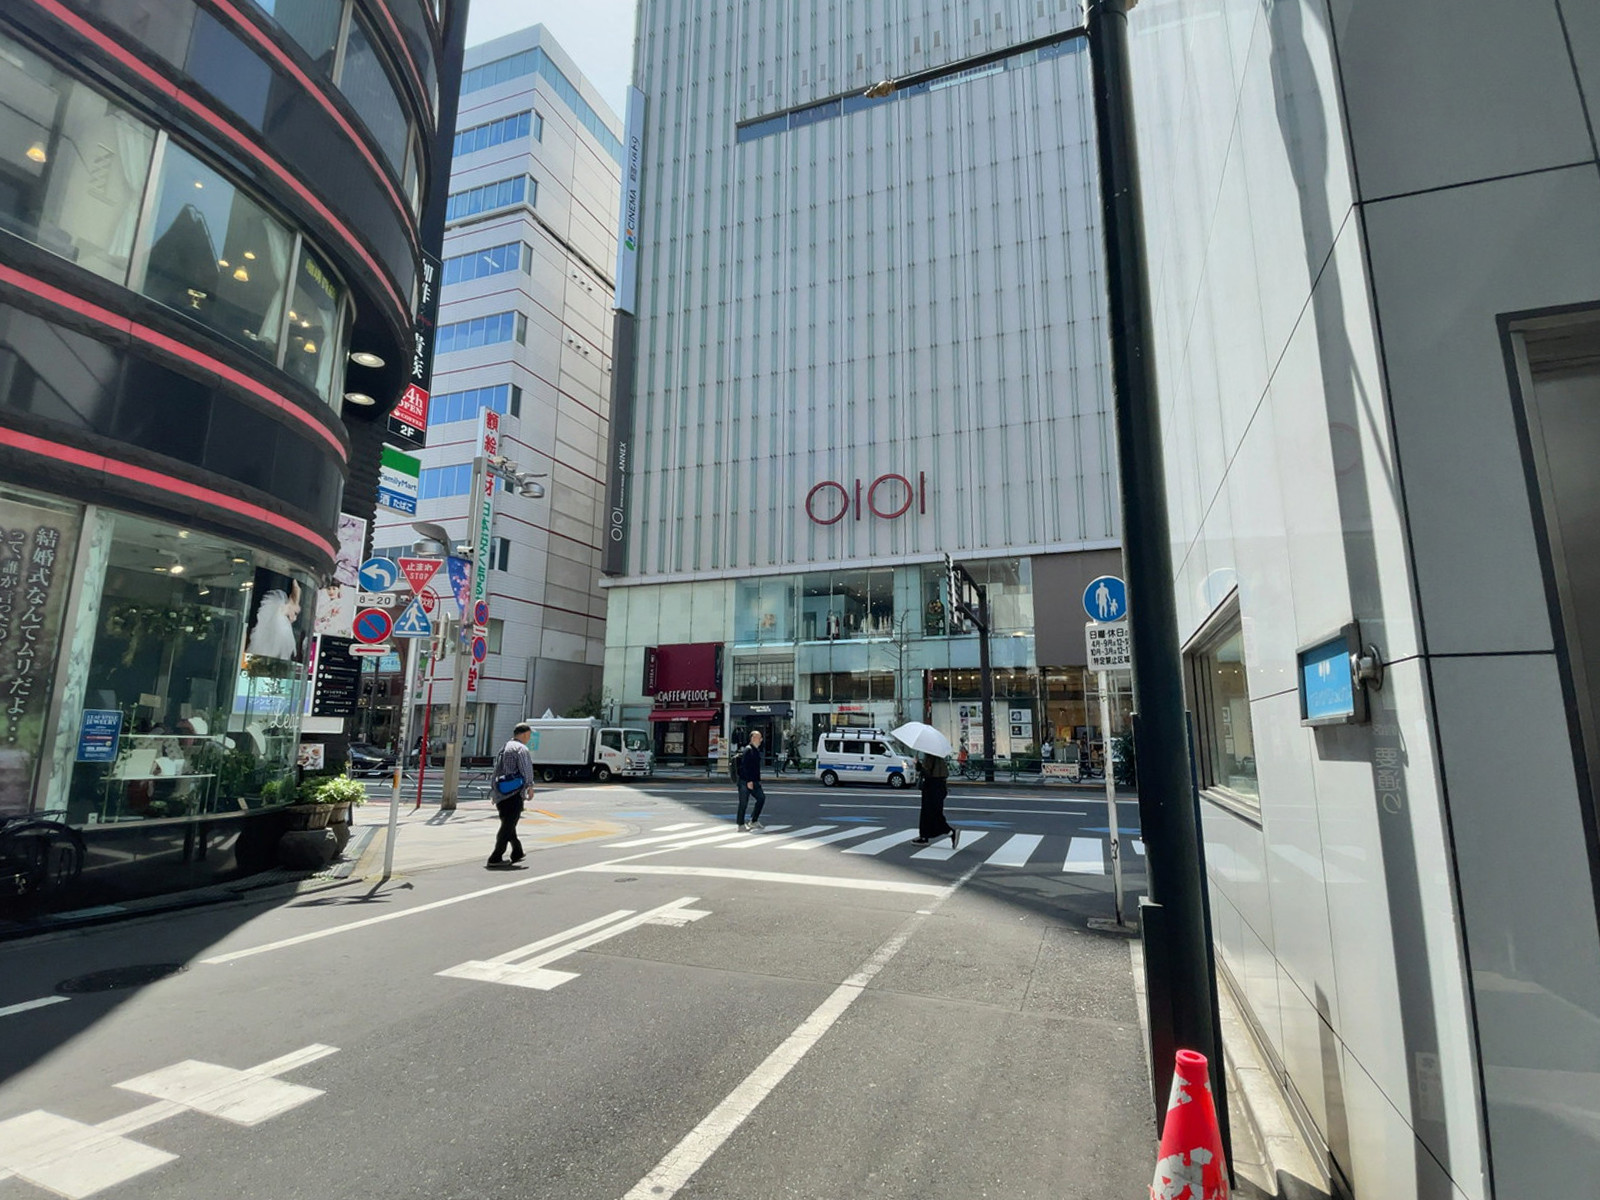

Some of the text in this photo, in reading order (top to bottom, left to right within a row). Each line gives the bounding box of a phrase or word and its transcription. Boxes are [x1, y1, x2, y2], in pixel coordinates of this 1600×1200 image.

[628, 188, 637, 231] CINEMA
[399, 424, 415, 438] 2F
[618, 441, 627, 472] ANNEX
[392, 498, 413, 512] たばこ
[406, 563, 433, 572] 止まれ
